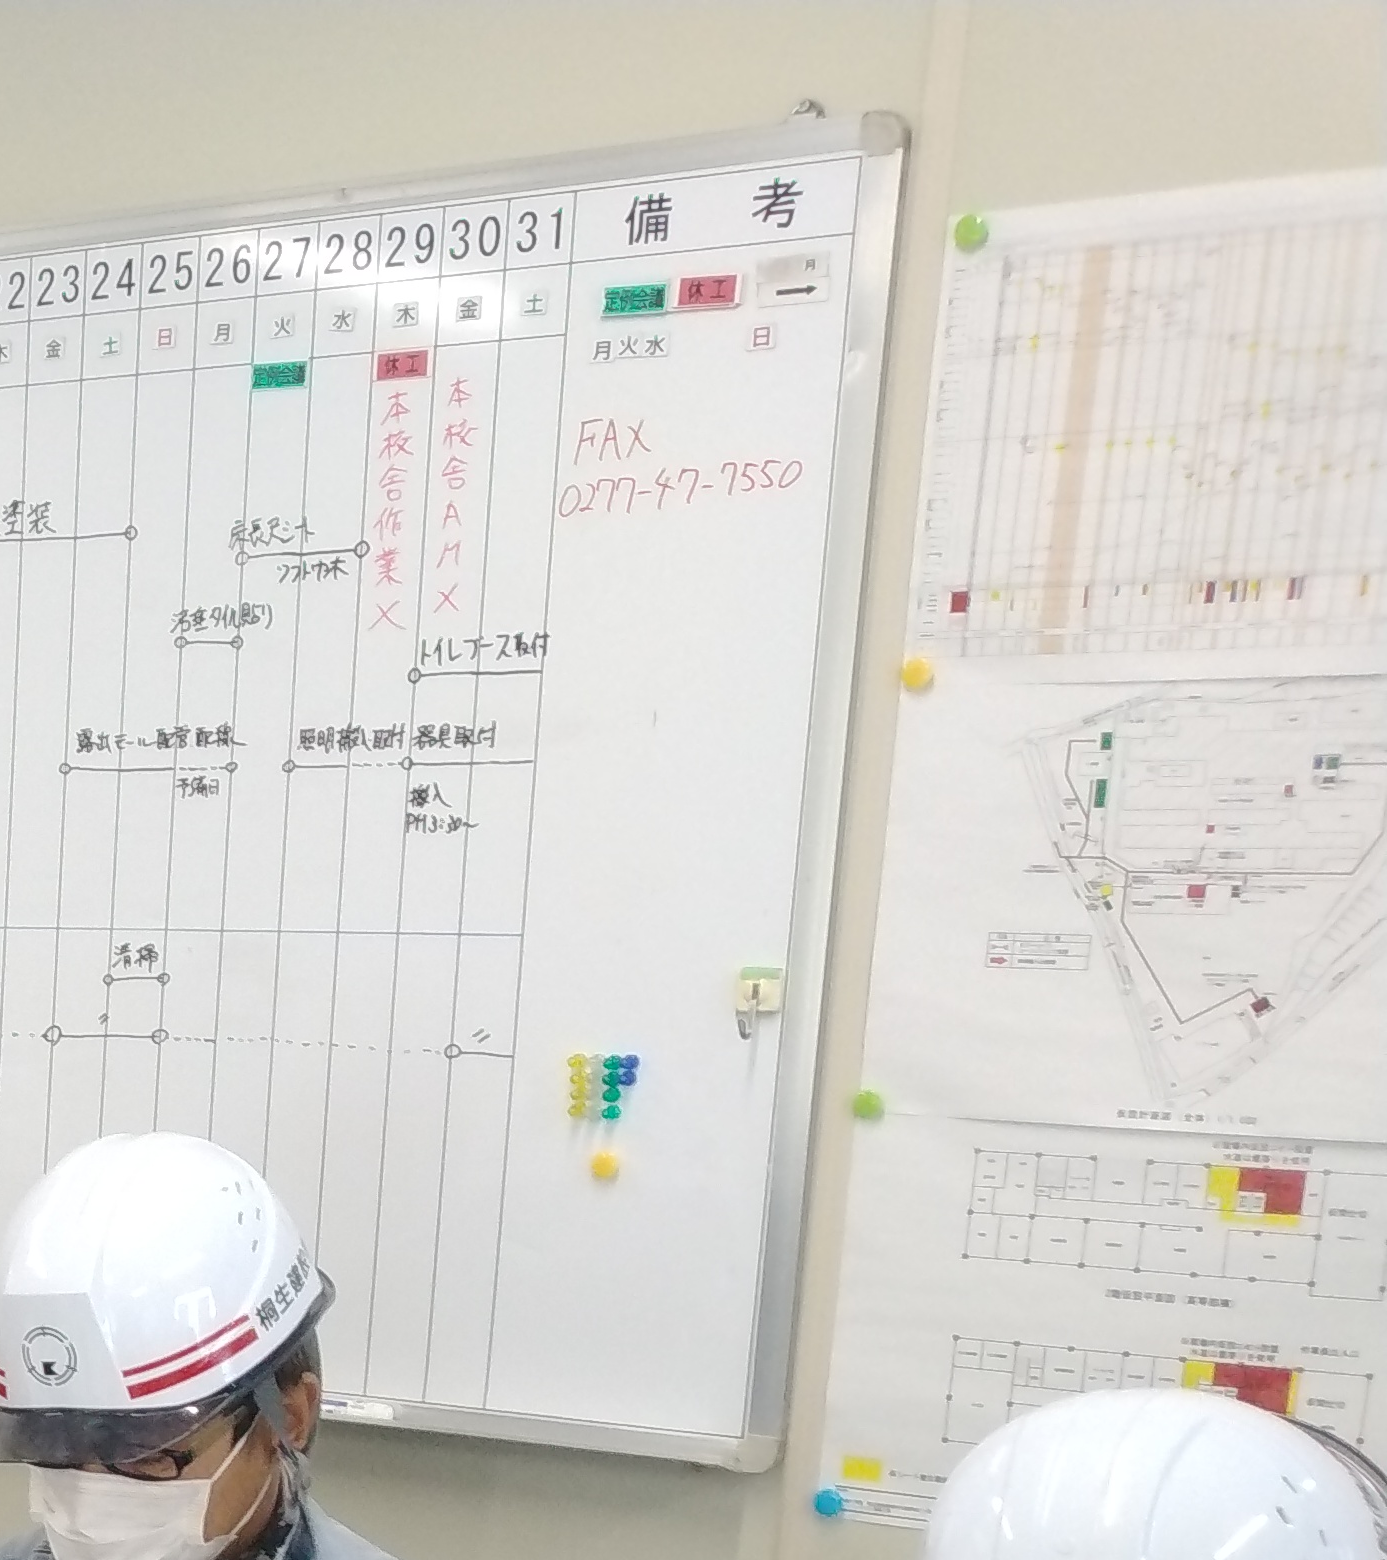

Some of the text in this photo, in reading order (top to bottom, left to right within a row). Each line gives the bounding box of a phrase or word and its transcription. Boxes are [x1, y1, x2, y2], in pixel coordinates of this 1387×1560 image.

[625, 178, 803, 246] 備考
[37, 266, 80, 305] 23
[92, 259, 135, 300] 24
[148, 251, 193, 294] 25
[205, 246, 250, 287] 26
[262, 238, 311, 281] 27
[324, 231, 372, 274] 28
[386, 224, 434, 267] 29
[450, 216, 500, 260] 30
[517, 208, 562, 252] 31
[688, 279, 727, 301] 休工
[46, 340, 61, 358] 金
[103, 337, 118, 355] 土
[158, 328, 174, 348] 日
[212, 324, 232, 345] 月
[271, 317, 293, 339] 火
[330, 310, 352, 331] 水
[396, 305, 416, 326] 木
[460, 300, 478, 319] 金
[524, 294, 545, 316] 土
[753, 327, 770, 347] 日
[384, 354, 421, 376] 休工
[574, 418, 652, 464] FAX
[558, 459, 804, 518] 0277-47-7550
